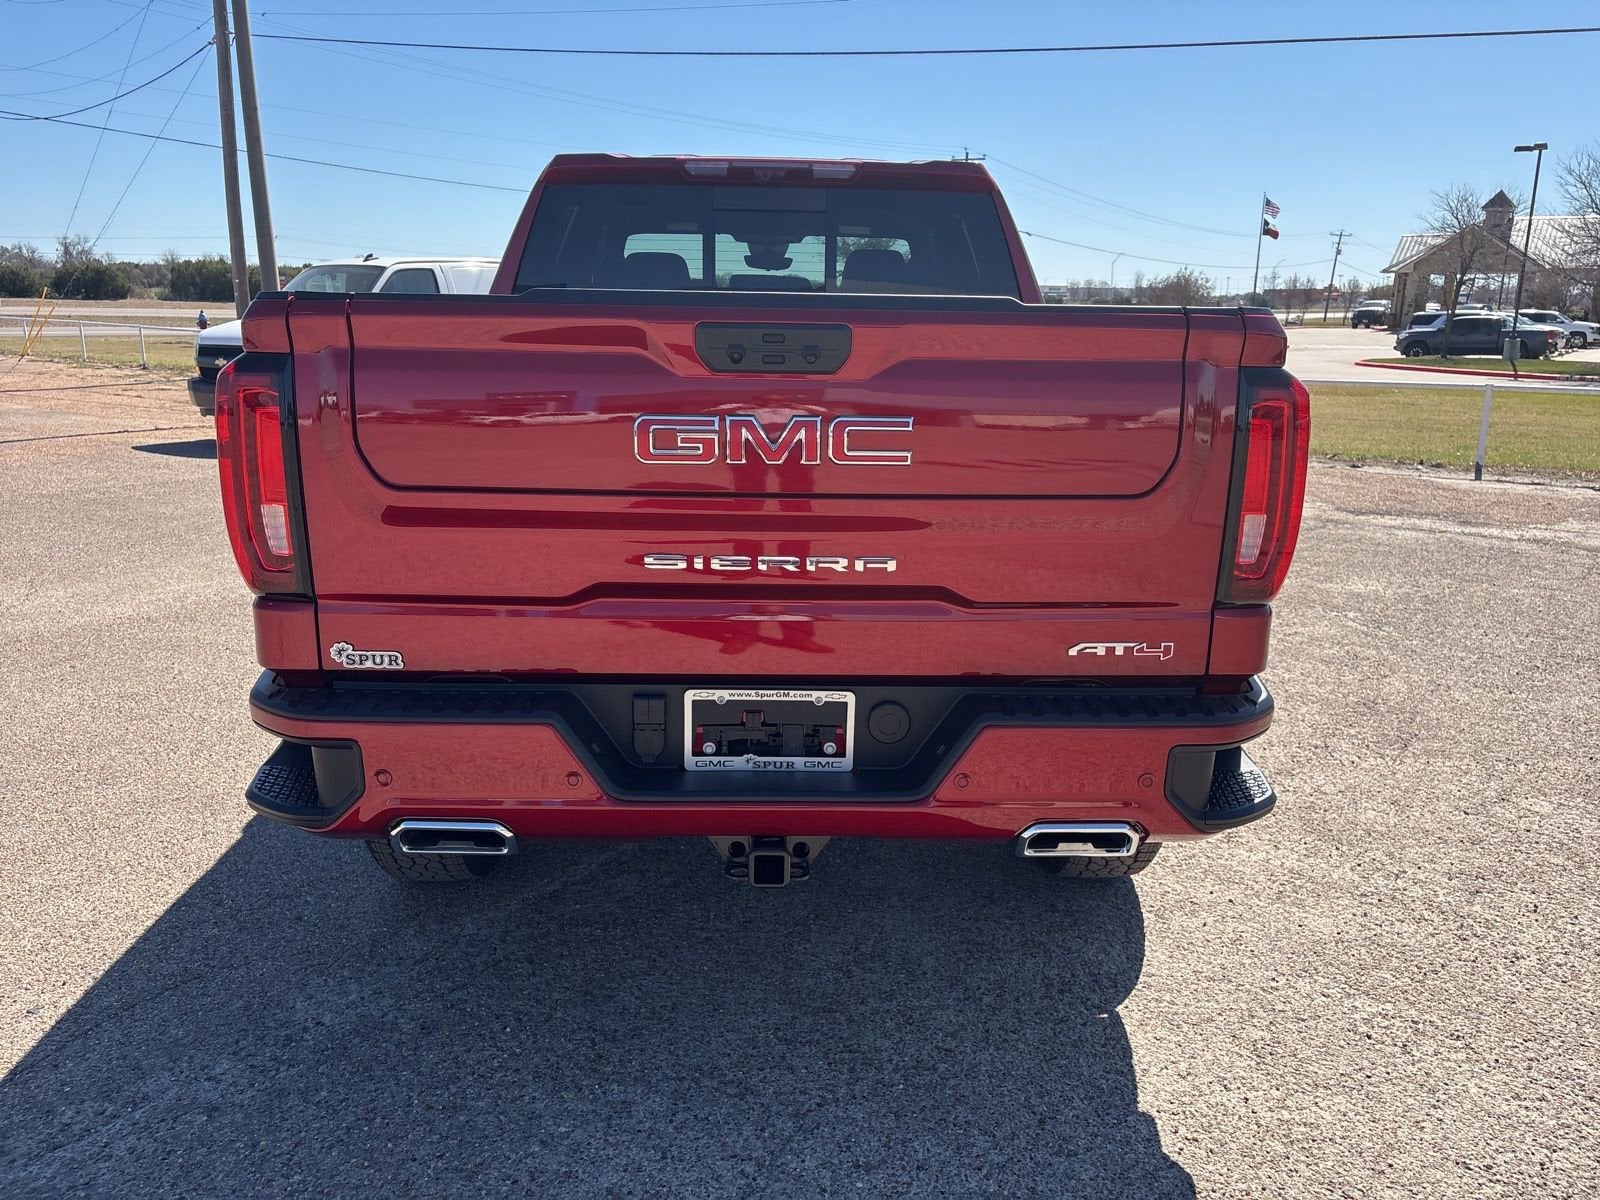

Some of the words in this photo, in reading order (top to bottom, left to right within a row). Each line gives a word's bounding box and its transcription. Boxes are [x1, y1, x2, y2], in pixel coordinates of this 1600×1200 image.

[634, 414, 914, 465] GMC
[643, 554, 897, 572] SIERRA
[1068, 642, 1174, 661] AT4
[345, 653, 400, 667] SPUR
[728, 691, 813, 700] www.SpurGM.com
[695, 760, 735, 768] GMC
[752, 760, 796, 770] SPUR
[803, 760, 843, 769] GMC
